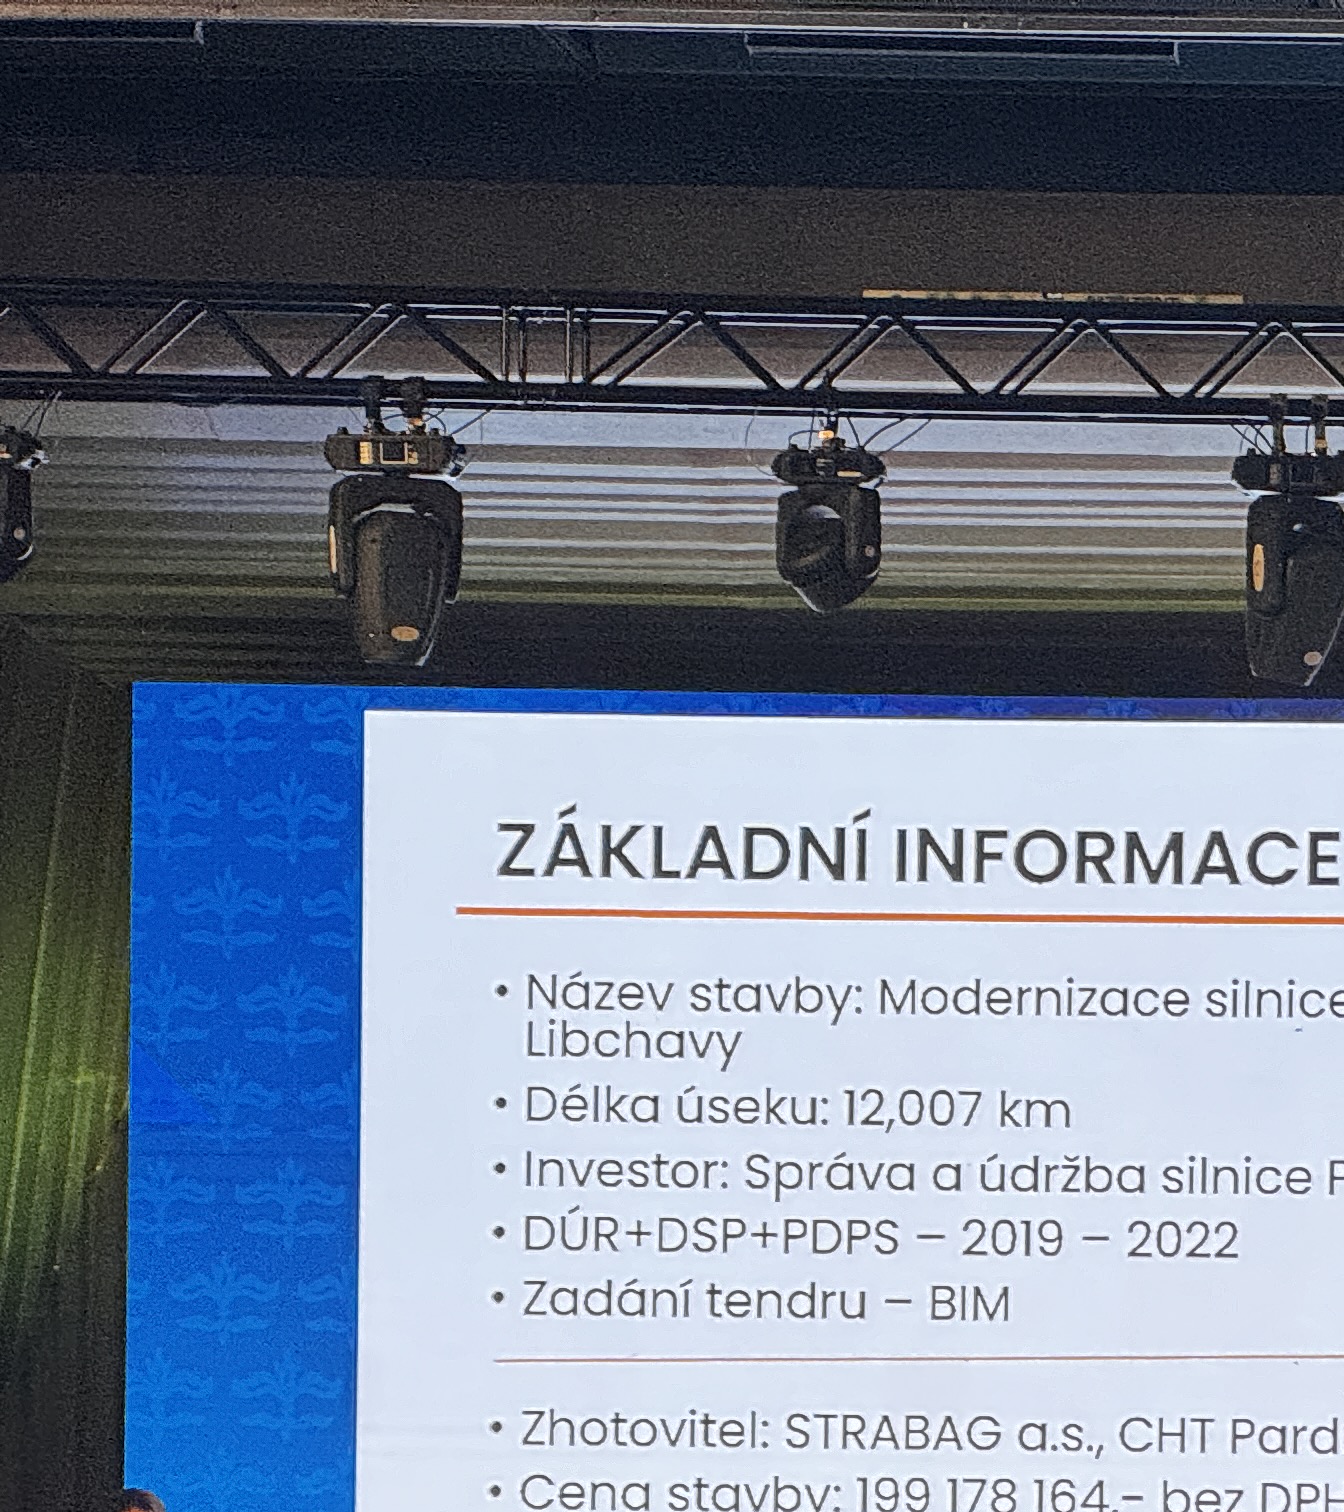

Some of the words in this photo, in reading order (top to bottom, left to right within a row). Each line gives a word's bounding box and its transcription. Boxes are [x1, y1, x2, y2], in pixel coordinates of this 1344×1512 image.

[496, 803, 872, 882] ZÁKLADNÍ
[895, 827, 1341, 887] INFORMACE
[527, 970, 675, 1012] Název
[690, 975, 863, 1026] stavby:
[880, 976, 1190, 1018] Modernizace
[527, 1018, 743, 1073] Libchavy
[526, 1083, 660, 1124] Délka
[677, 1085, 829, 1126] úseku:
[843, 1088, 983, 1134] 12,007
[1000, 1089, 1071, 1129] km
[525, 1150, 729, 1190] Investor:
[745, 1151, 915, 1203] Správa
[932, 1163, 962, 1192] a
[980, 1153, 1146, 1194] údržba
[1161, 1155, 1312, 1195] silnice
[524, 1204, 899, 1255] DÚR+DSP+PDPS
[962, 1218, 1063, 1257] 2019
[1127, 1220, 1239, 1259] 2022
[523, 1278, 694, 1318] Zadání
[705, 1281, 866, 1320] tendru
[930, 1285, 1010, 1322] BIM
[521, 1408, 769, 1449] Zhotovitel:
[785, 1413, 1002, 1451] STRABAG
[1017, 1422, 1104, 1460] a.s.,
[1119, 1416, 1216, 1454] CHT
[519, 1474, 650, 1512] Cena
